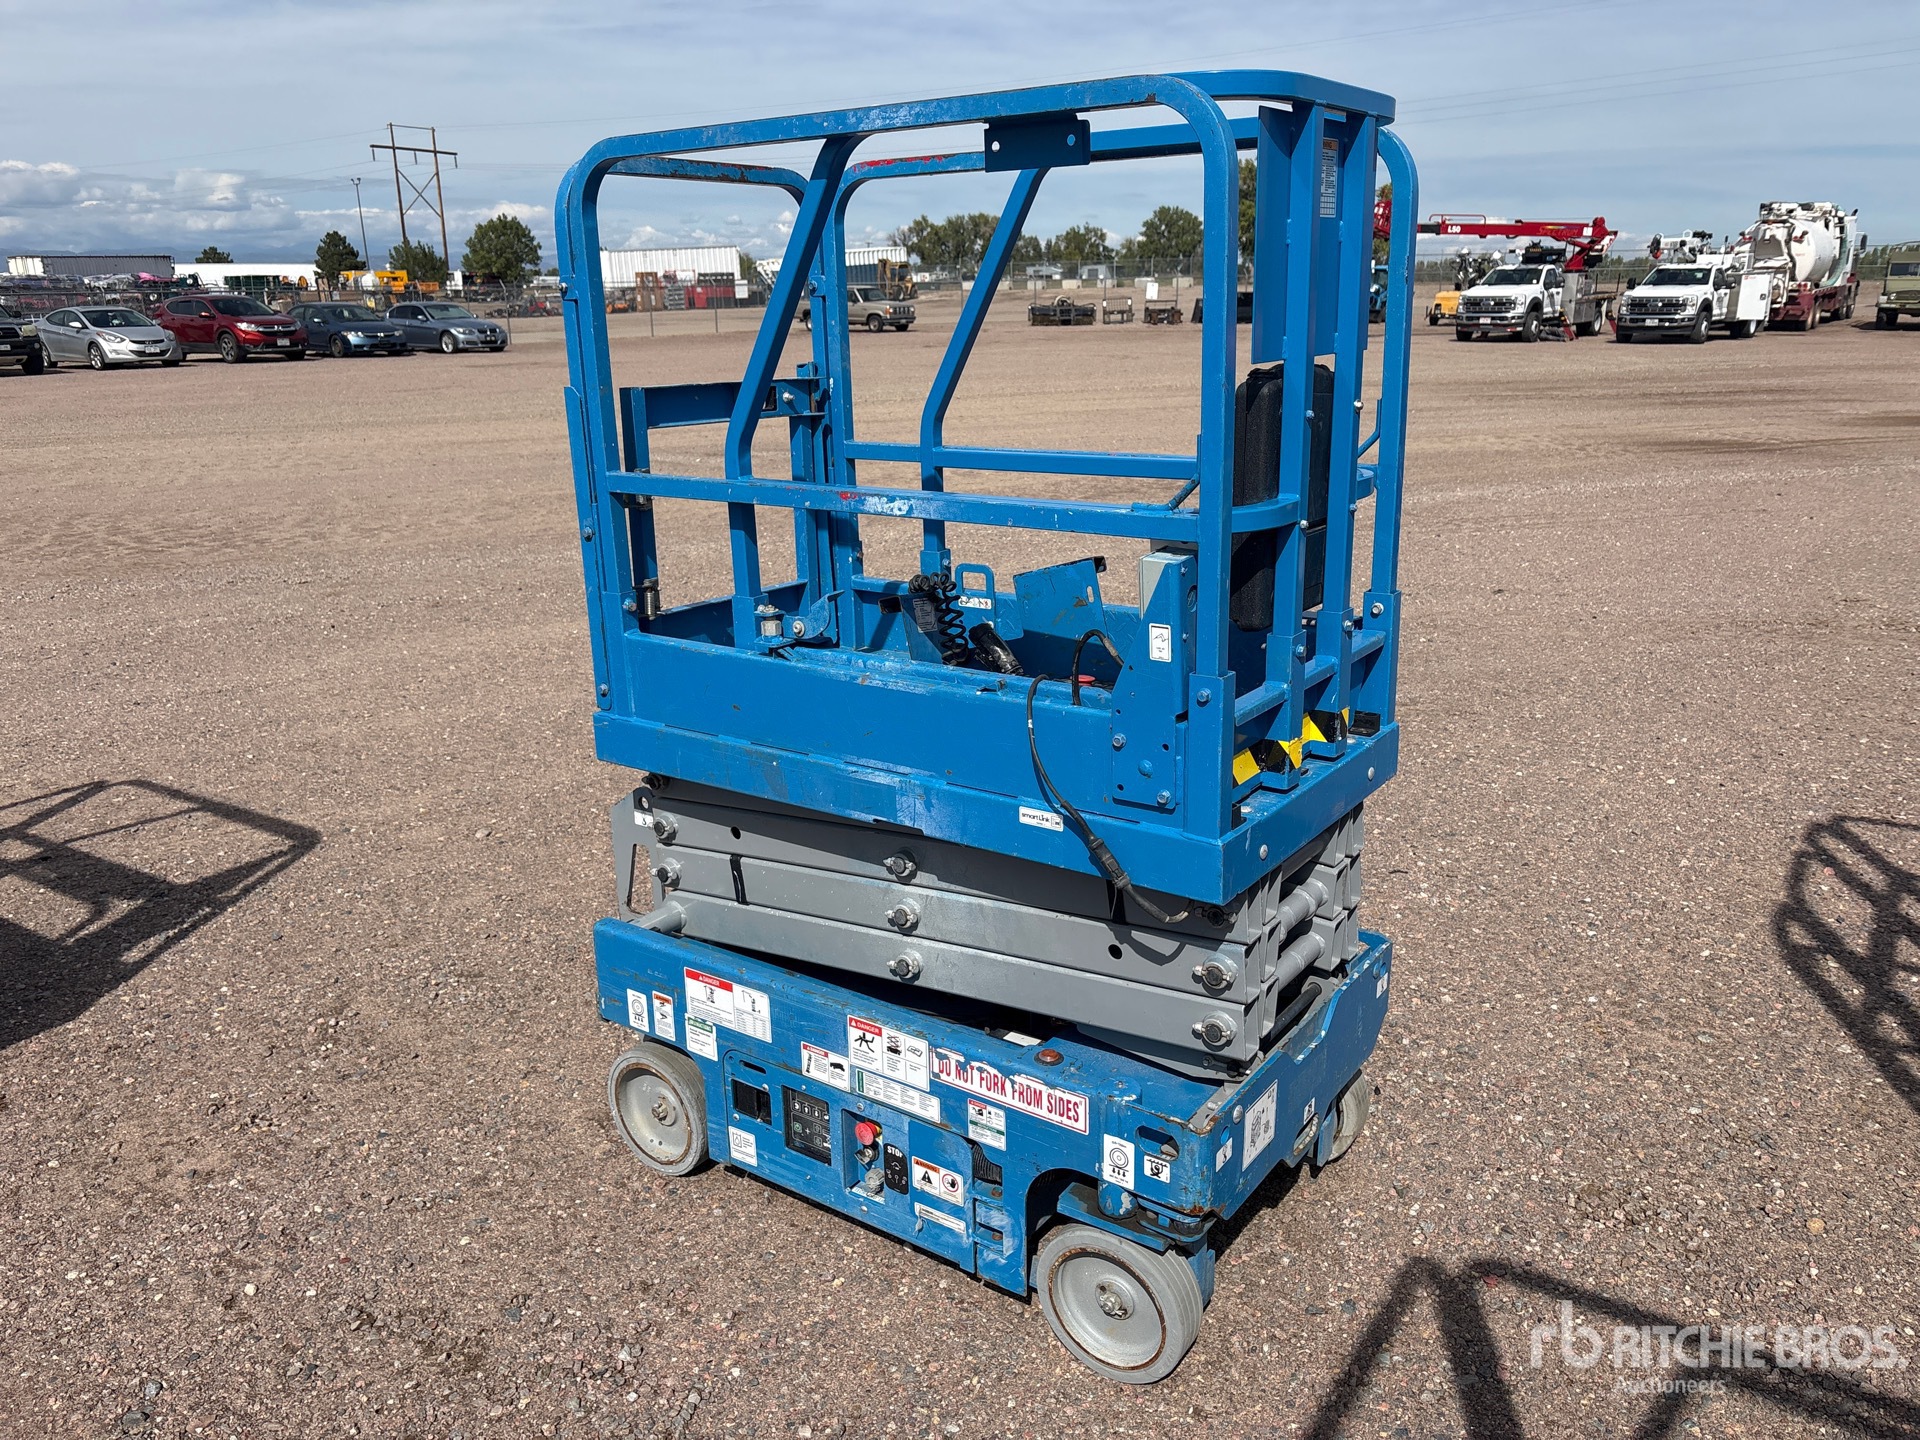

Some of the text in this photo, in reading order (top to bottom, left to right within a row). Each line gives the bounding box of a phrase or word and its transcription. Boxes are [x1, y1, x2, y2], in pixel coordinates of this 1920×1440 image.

[856, 1021, 880, 1034] DANGER
[938, 1057, 1079, 1123] DO NOT FORK FROM SIDES
